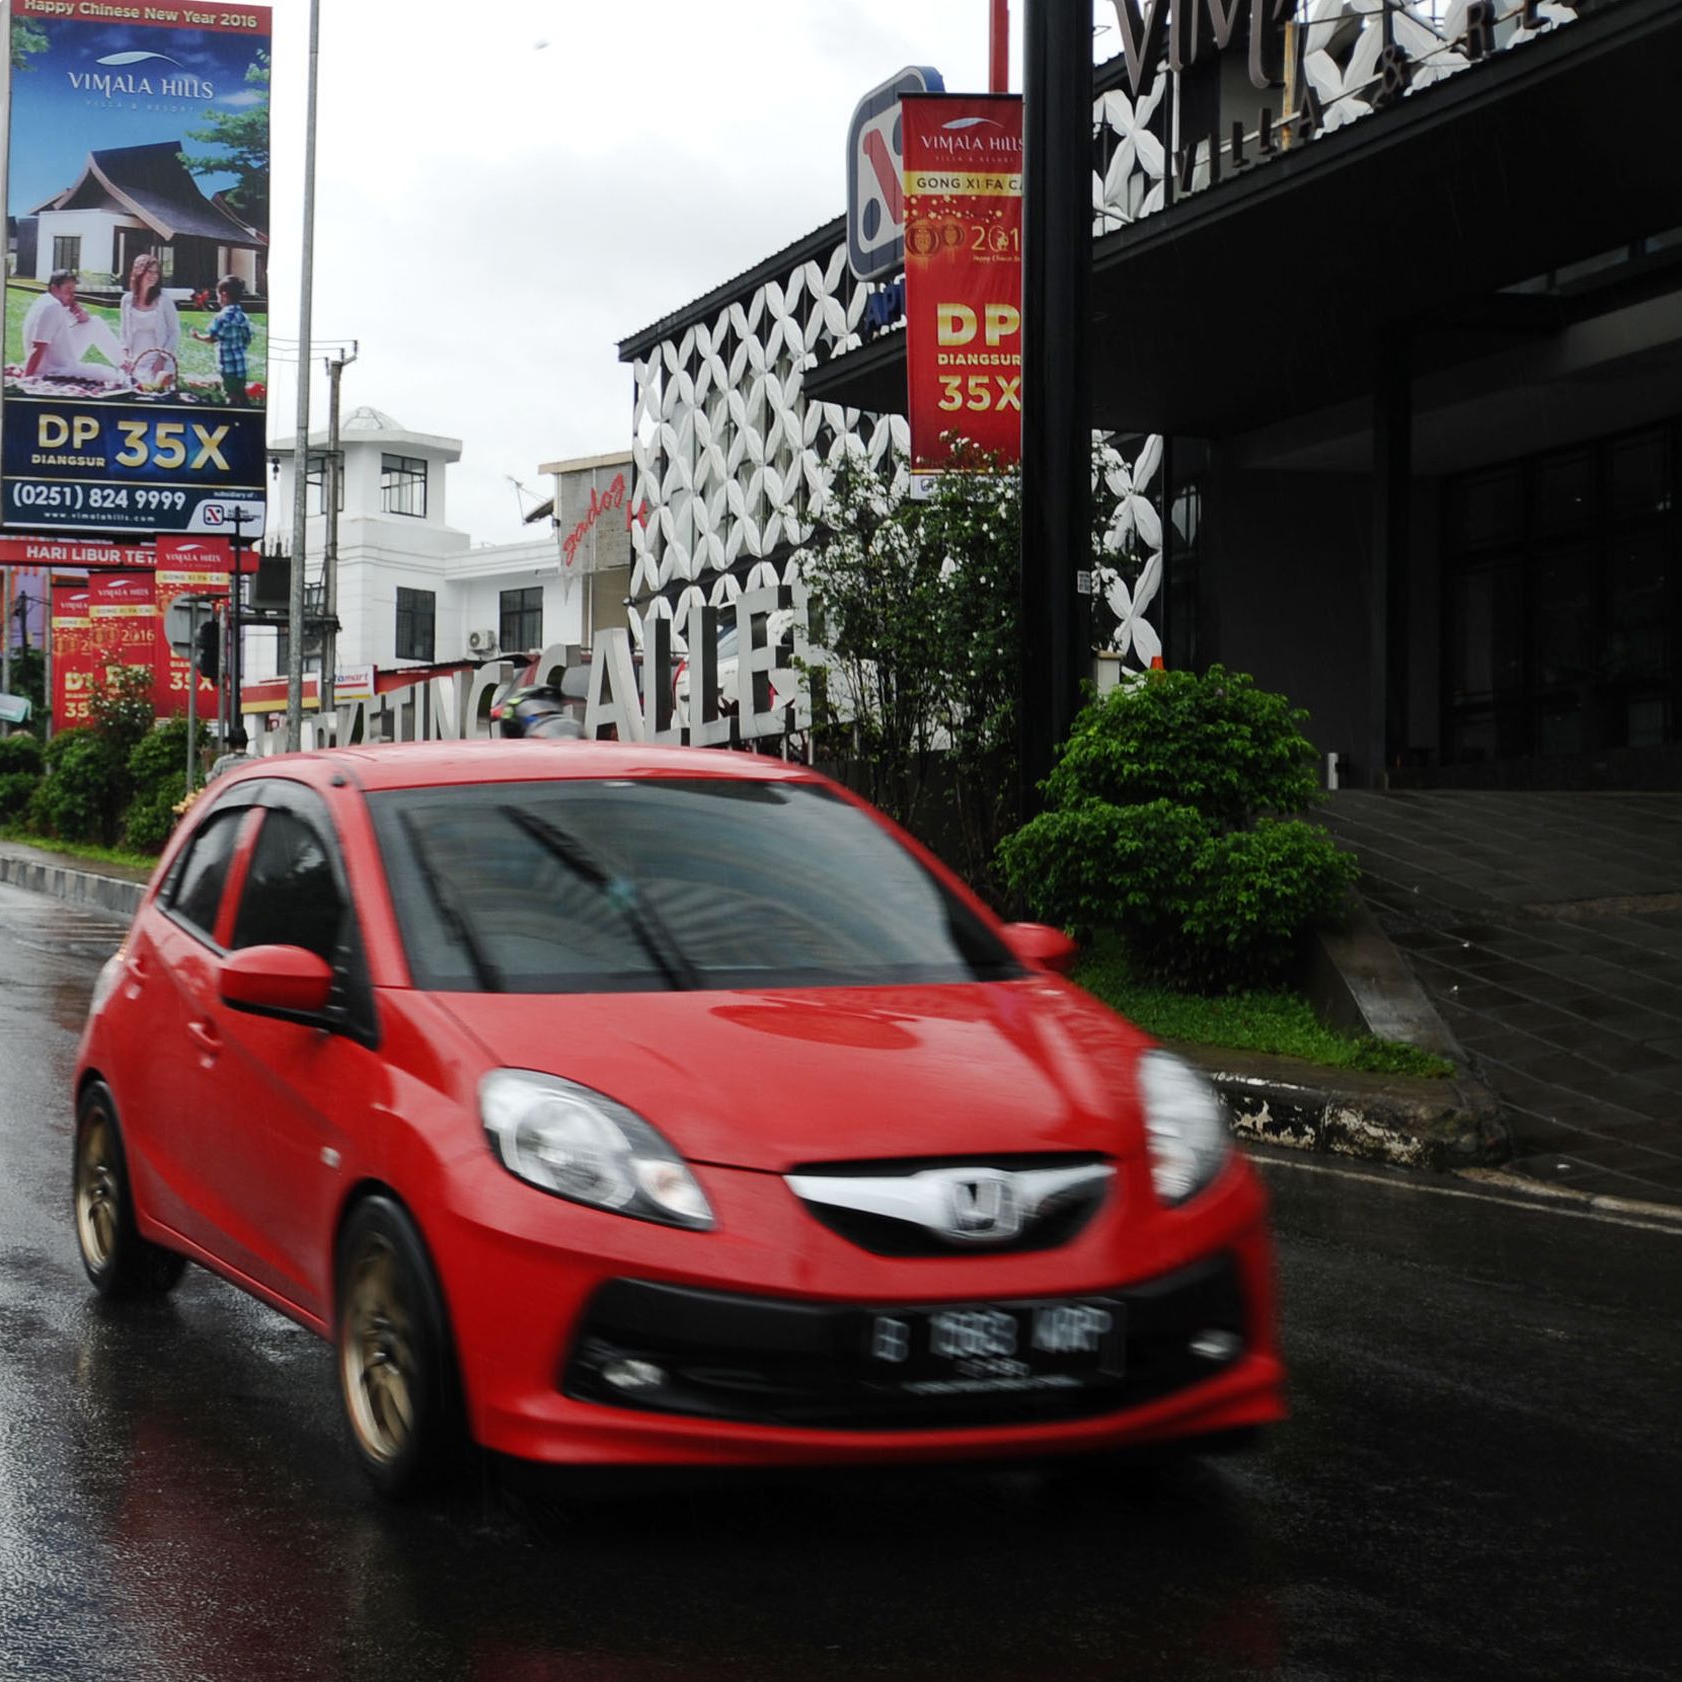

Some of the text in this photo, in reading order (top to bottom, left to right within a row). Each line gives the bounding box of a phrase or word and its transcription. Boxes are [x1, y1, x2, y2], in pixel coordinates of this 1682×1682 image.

[24, 0, 258, 28] Happy Chinese New Year 2016
[67, 72, 214, 100] VIMALA HILLS
[920, 134, 984, 155] VIMALA
[916, 177, 961, 189] GONG
[966, 178, 980, 190] XI
[985, 178, 1004, 190] FA
[937, 303, 1021, 347] DP
[937, 353, 1021, 366] DIANGSUR
[937, 375, 1021, 412] 35X
[38, 414, 100, 450] DP
[31, 454, 106, 467] DIANGSUR
[13, 482, 186, 511] (0251) 824 9999
[26, 544, 157, 565] HARI LIBUR TET
